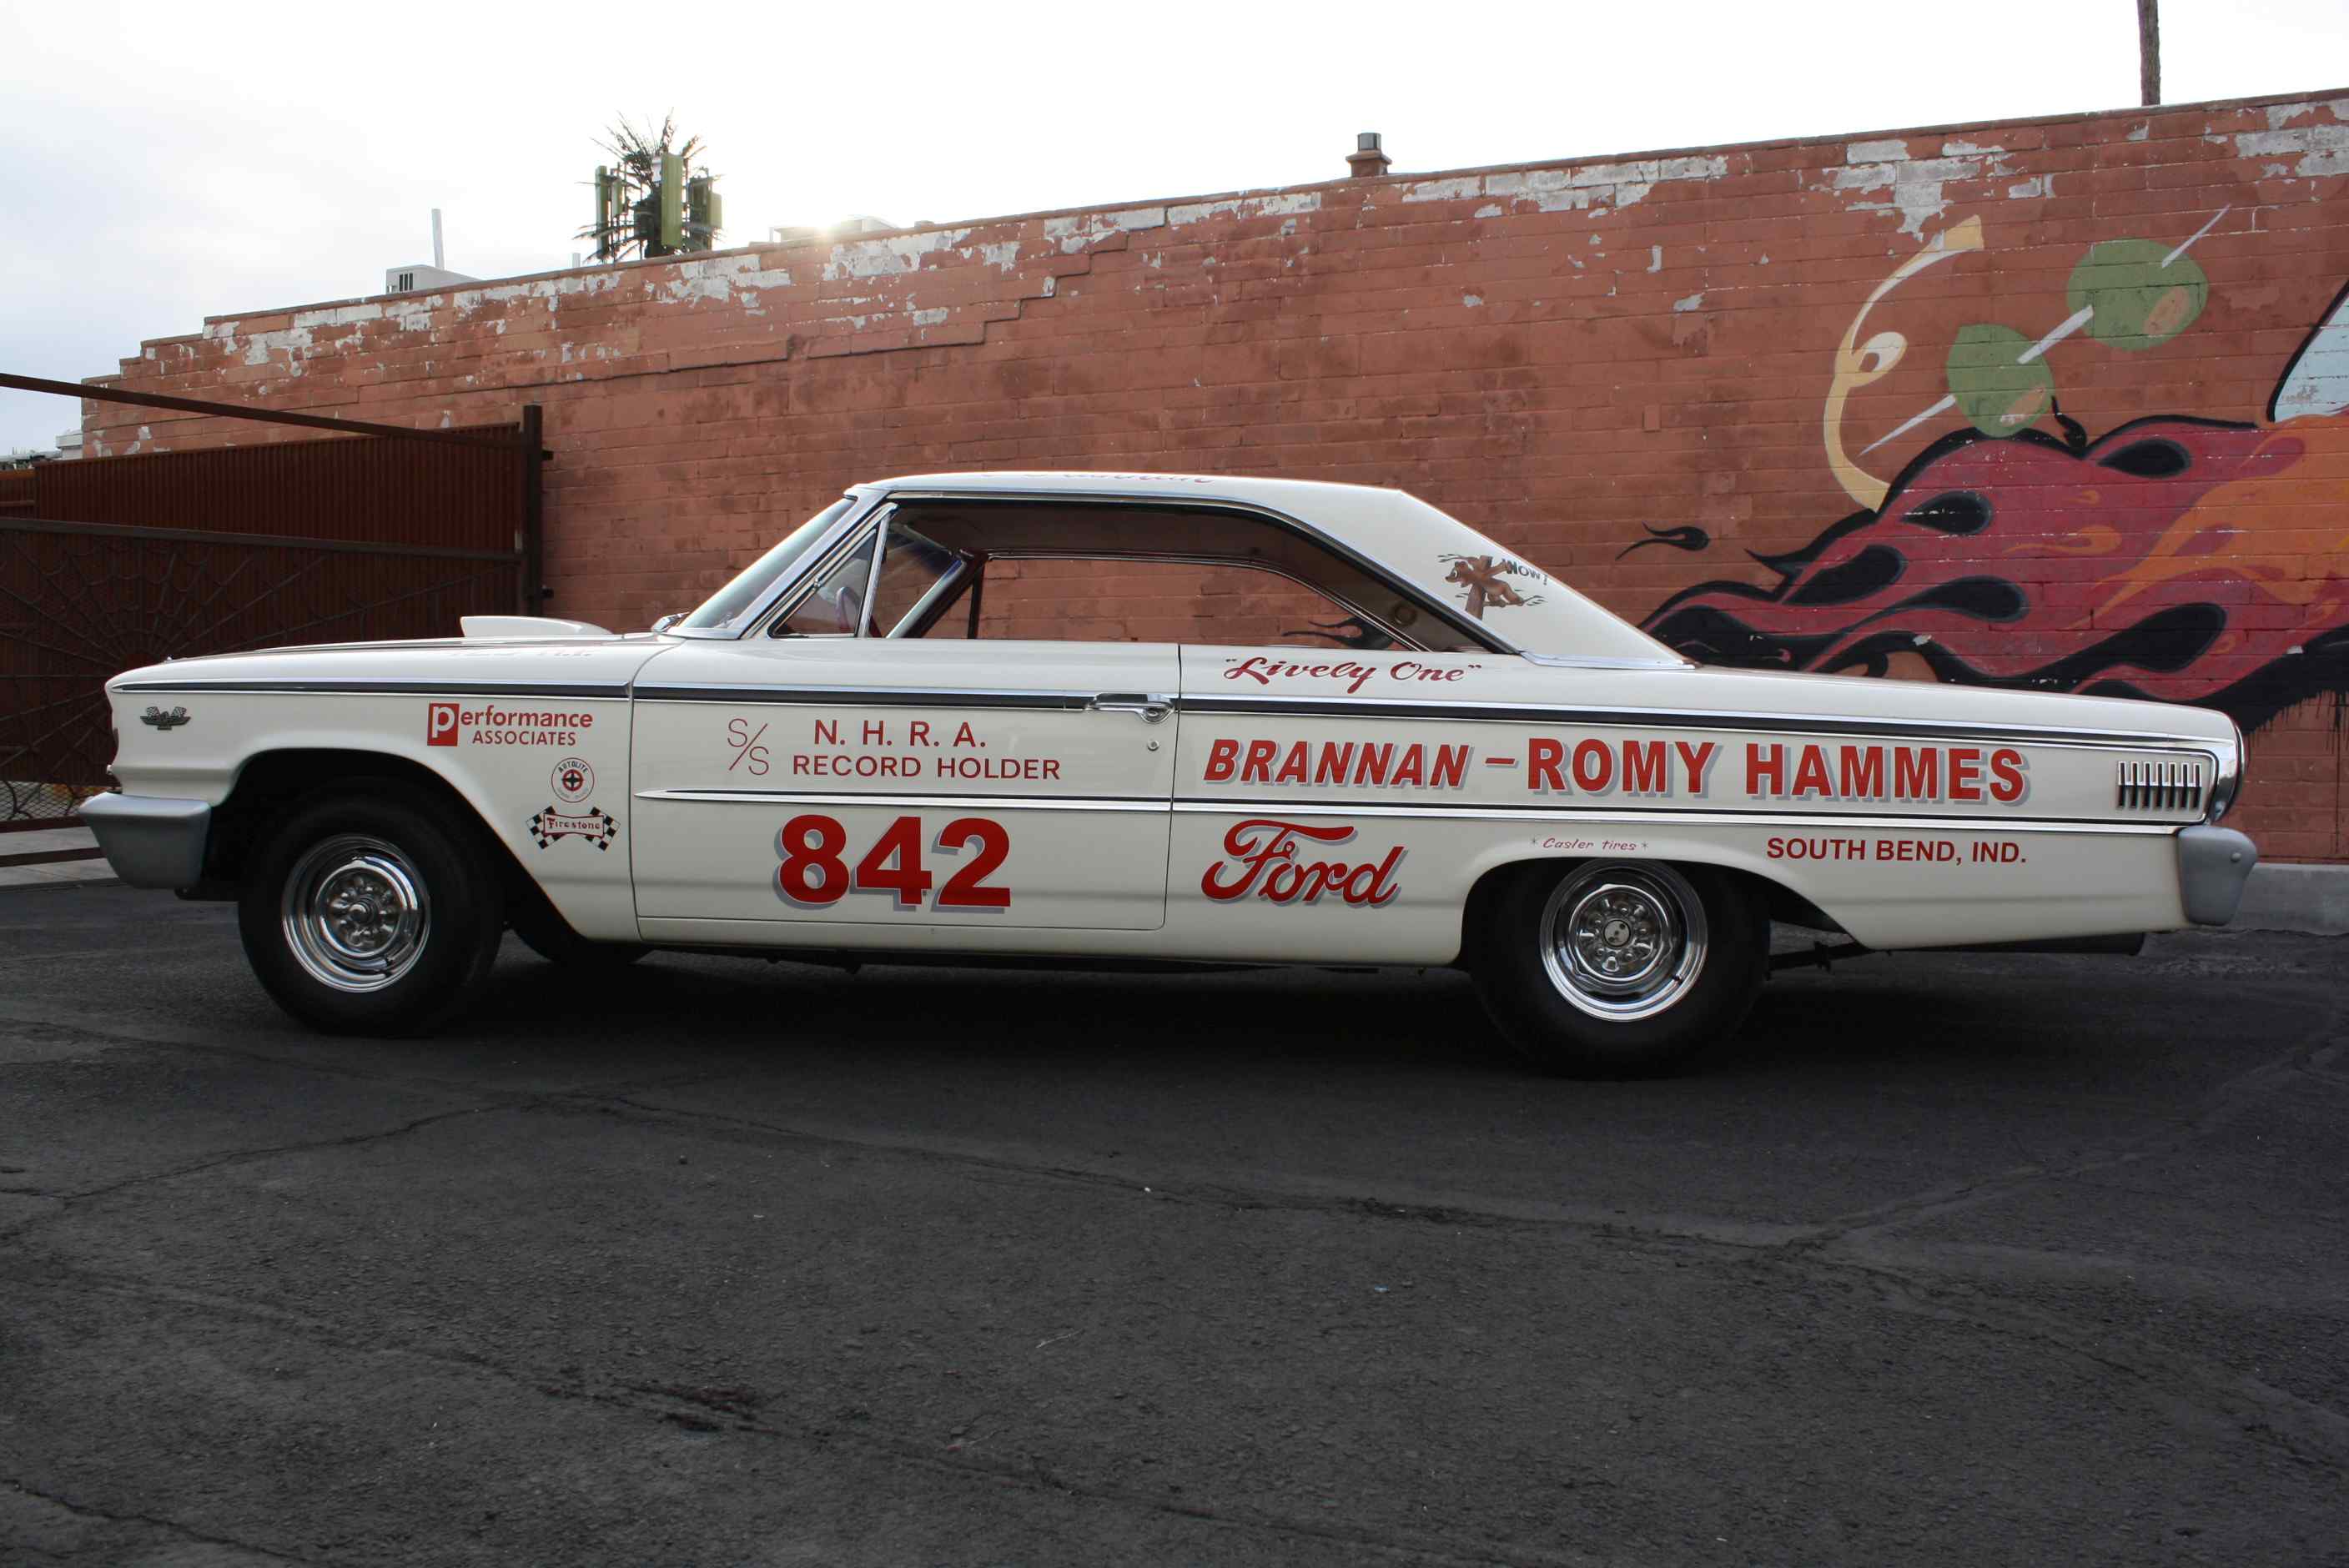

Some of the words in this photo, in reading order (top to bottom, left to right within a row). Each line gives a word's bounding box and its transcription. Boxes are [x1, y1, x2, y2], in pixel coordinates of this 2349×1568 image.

[472, 731, 576, 746] ASSOCIATES
[558, 760, 589, 774] AUTOLITE
[792, 755, 922, 778] RECORD
[937, 756, 1061, 781] HOLDER
[1203, 739, 1472, 790] BRANNAN
[1527, 738, 1723, 797] ROMY
[1745, 742, 2031, 806] HAMMES
[546, 817, 601, 832] Firestone
[1542, 837, 1594, 849] Casler
[1602, 839, 1637, 851] tires
[1766, 837, 1867, 861] SOUTH
[1875, 840, 1963, 865] BEND,
[1972, 841, 2028, 864] IND.
[772, 814, 1012, 914] 842
[1200, 818, 1408, 907] Ford
